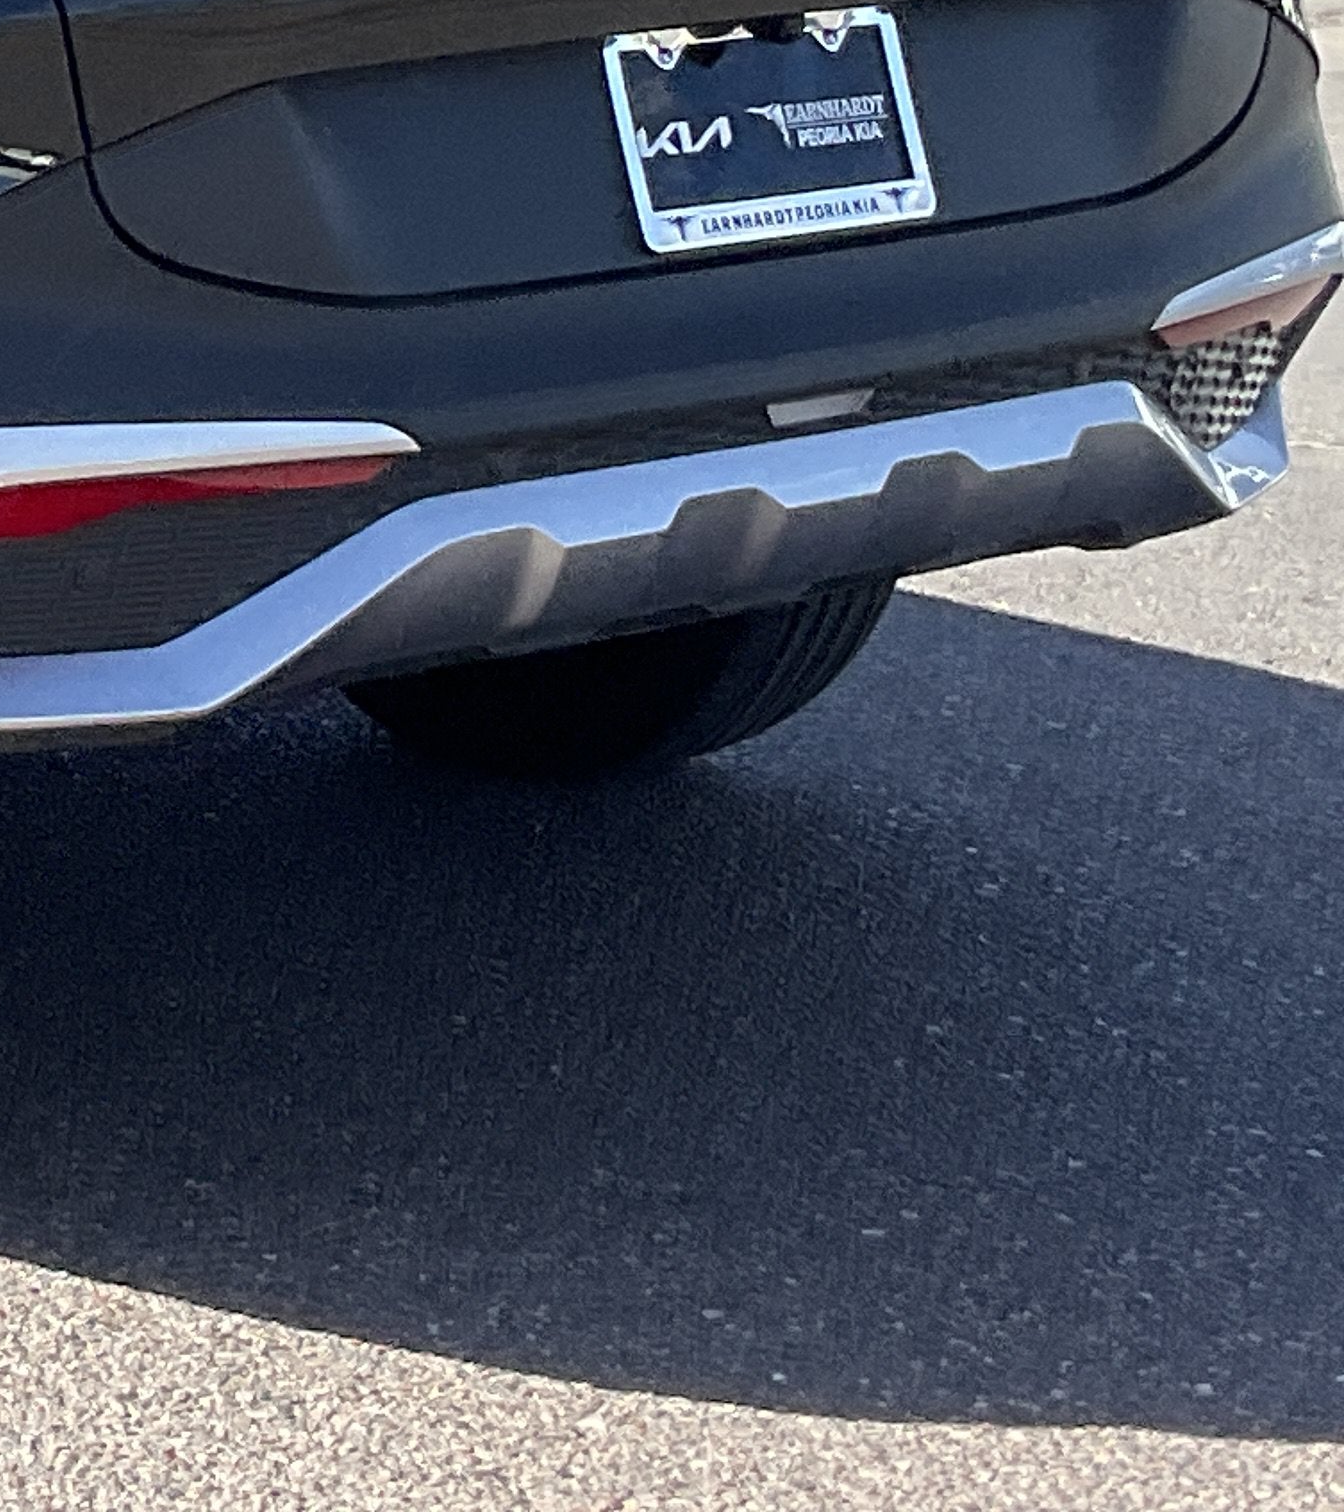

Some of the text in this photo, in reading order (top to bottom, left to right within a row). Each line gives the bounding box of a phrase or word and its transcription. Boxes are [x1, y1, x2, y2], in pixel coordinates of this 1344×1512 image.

[783, 94, 885, 124] EARNHARDT
[636, 115, 733, 158] KIA
[797, 120, 885, 148] PEORIA KIA
